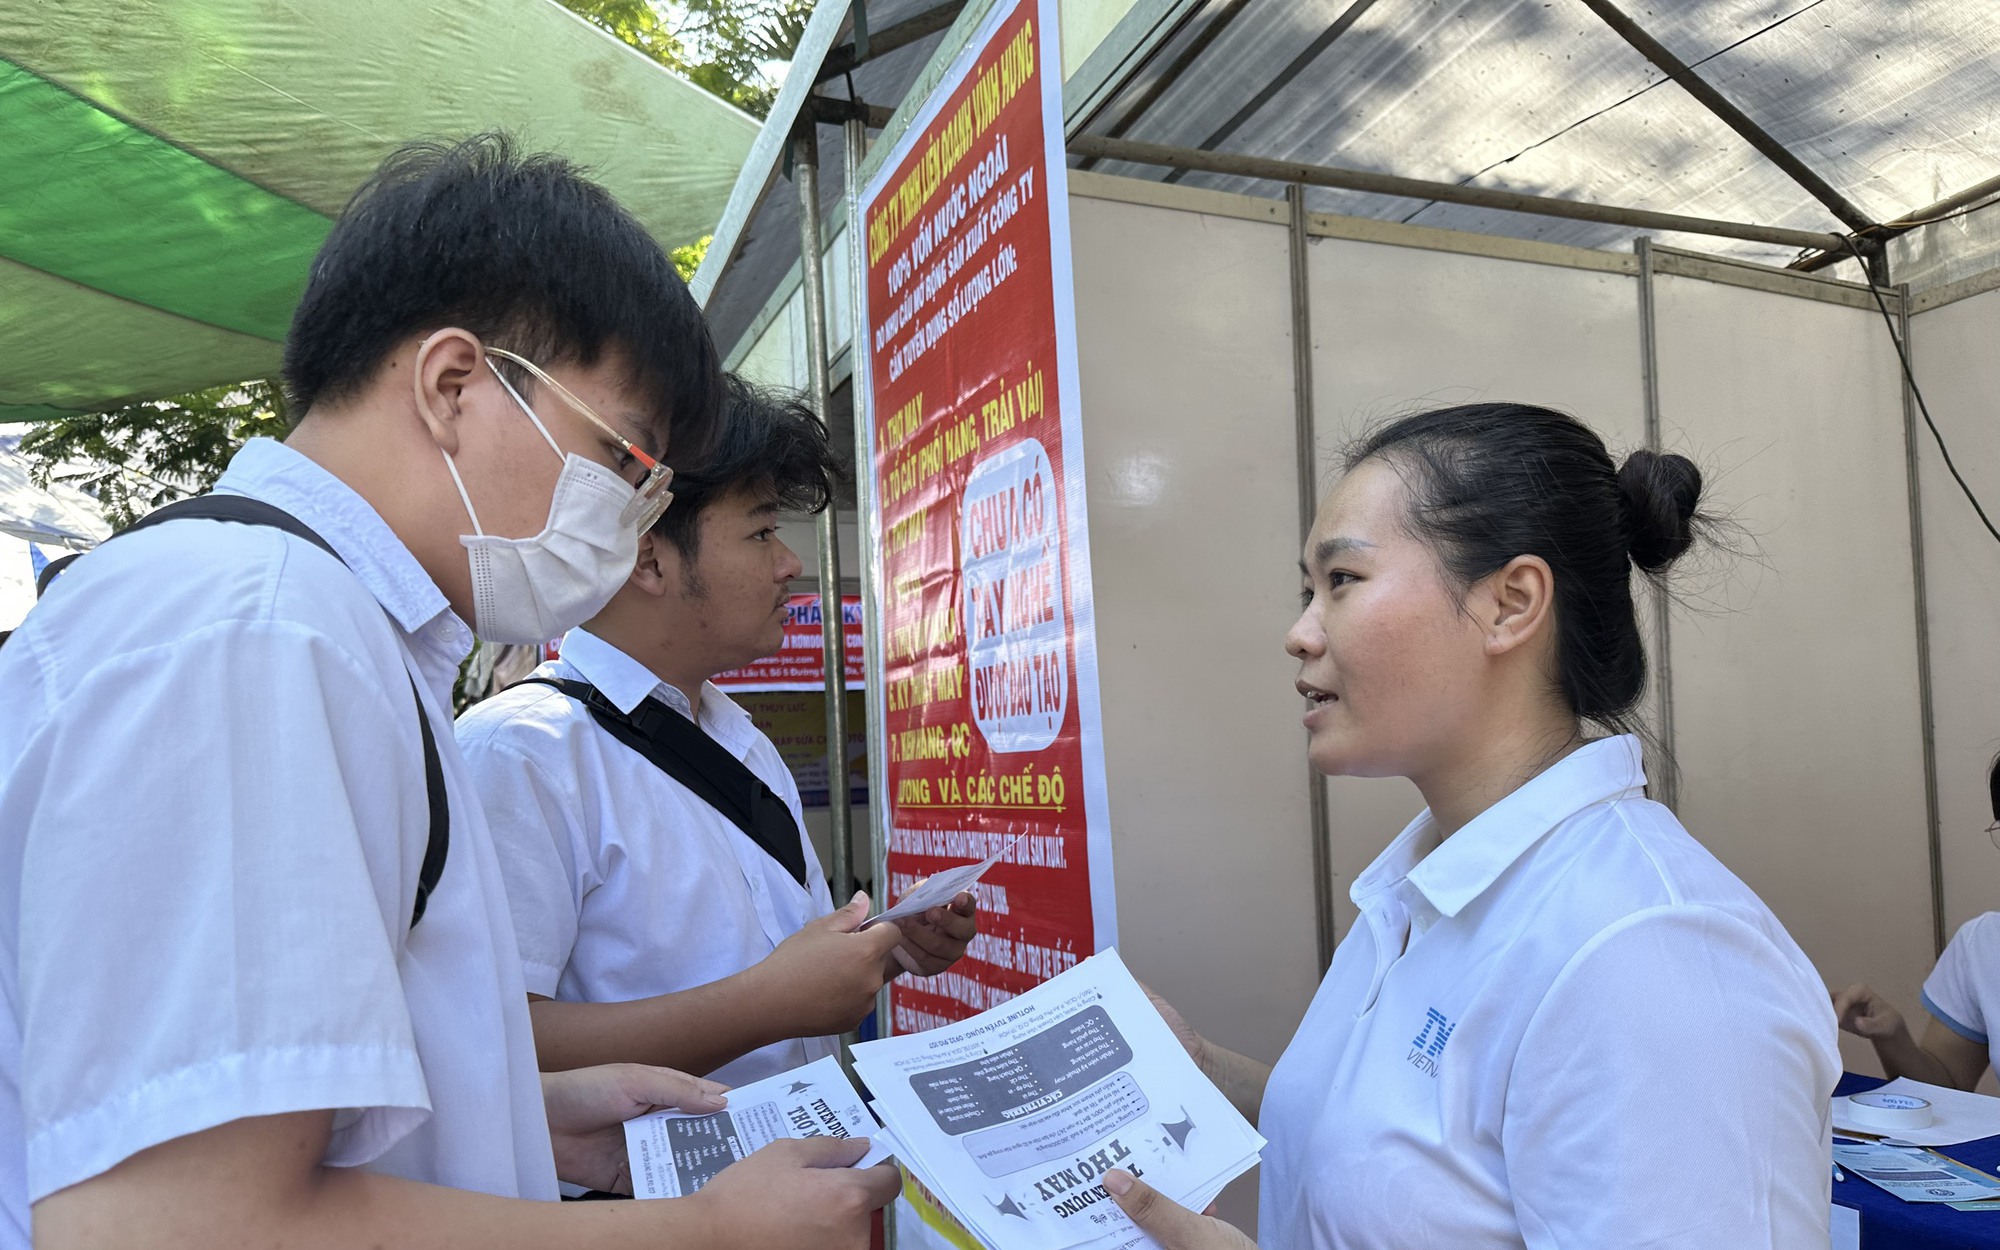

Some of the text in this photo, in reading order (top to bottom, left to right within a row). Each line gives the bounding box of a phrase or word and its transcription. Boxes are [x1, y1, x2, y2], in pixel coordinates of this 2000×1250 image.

[888, 133, 1008, 298] 100% VỐN NƯỚC NGOÀI
[965, 207, 987, 260] XUẤT
[990, 185, 1017, 236] CÔNG
[1019, 166, 1032, 206] TY
[947, 282, 959, 328] SỐ
[982, 378, 1014, 440] TRẢI
[970, 454, 1044, 559] CHƯA CÓ
[1033, 650, 1061, 729] TẠO
[951, 722, 970, 758] QC
[898, 763, 1064, 812] ƯƠNG VÀ CÁC CHẾ ĐỘ
[984, 1018, 1006, 1031] TUYỂN
[1006, 1005, 1034, 1022] HOTLINE
[1083, 1018, 1094, 1027] QC
[1061, 1038, 1076, 1048] hàng
[1087, 1026, 1099, 1036] Thợ
[1092, 1033, 1104, 1043] Thợ
[1070, 1055, 1084, 1065] hàng
[1097, 1041, 1109, 1051] Thợ
[1013, 1065, 1023, 1073] QA
[1053, 1049, 1114, 1084] Nhân viên kỹ thuật may
[1407, 1048, 1439, 1078] VIETN
[1045, 1090, 1062, 1103] CÁC
[787, 1105, 817, 1130] THỢ
[810, 1098, 850, 1140] TUYỂN DỤN
[1033, 1138, 1131, 1201] THỢ MAY
[1052, 1190, 1096, 1218] DỤNG
